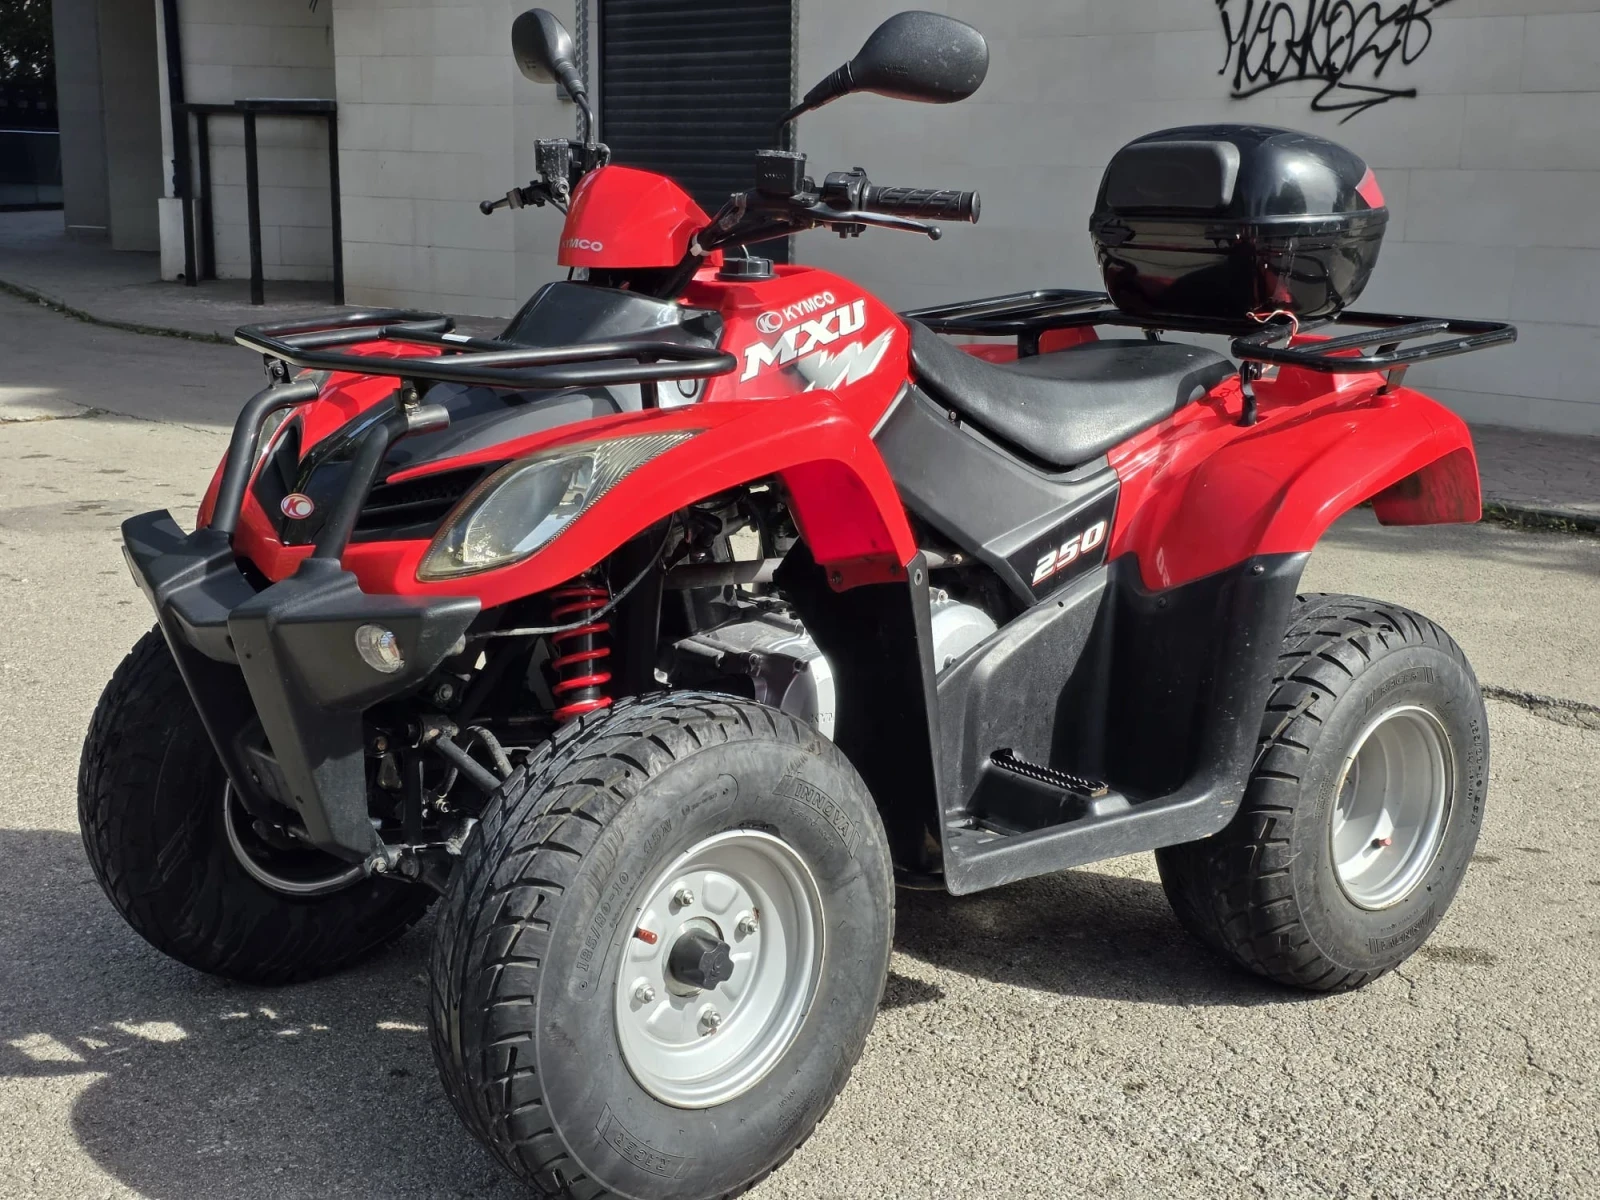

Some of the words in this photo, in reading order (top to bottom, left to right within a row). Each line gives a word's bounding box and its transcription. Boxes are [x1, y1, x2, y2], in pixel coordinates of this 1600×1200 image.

[782, 290, 836, 322] KYMCO
[740, 298, 866, 383] MXU
[1031, 520, 1107, 587] 250
[794, 783, 849, 838] INNOVA
